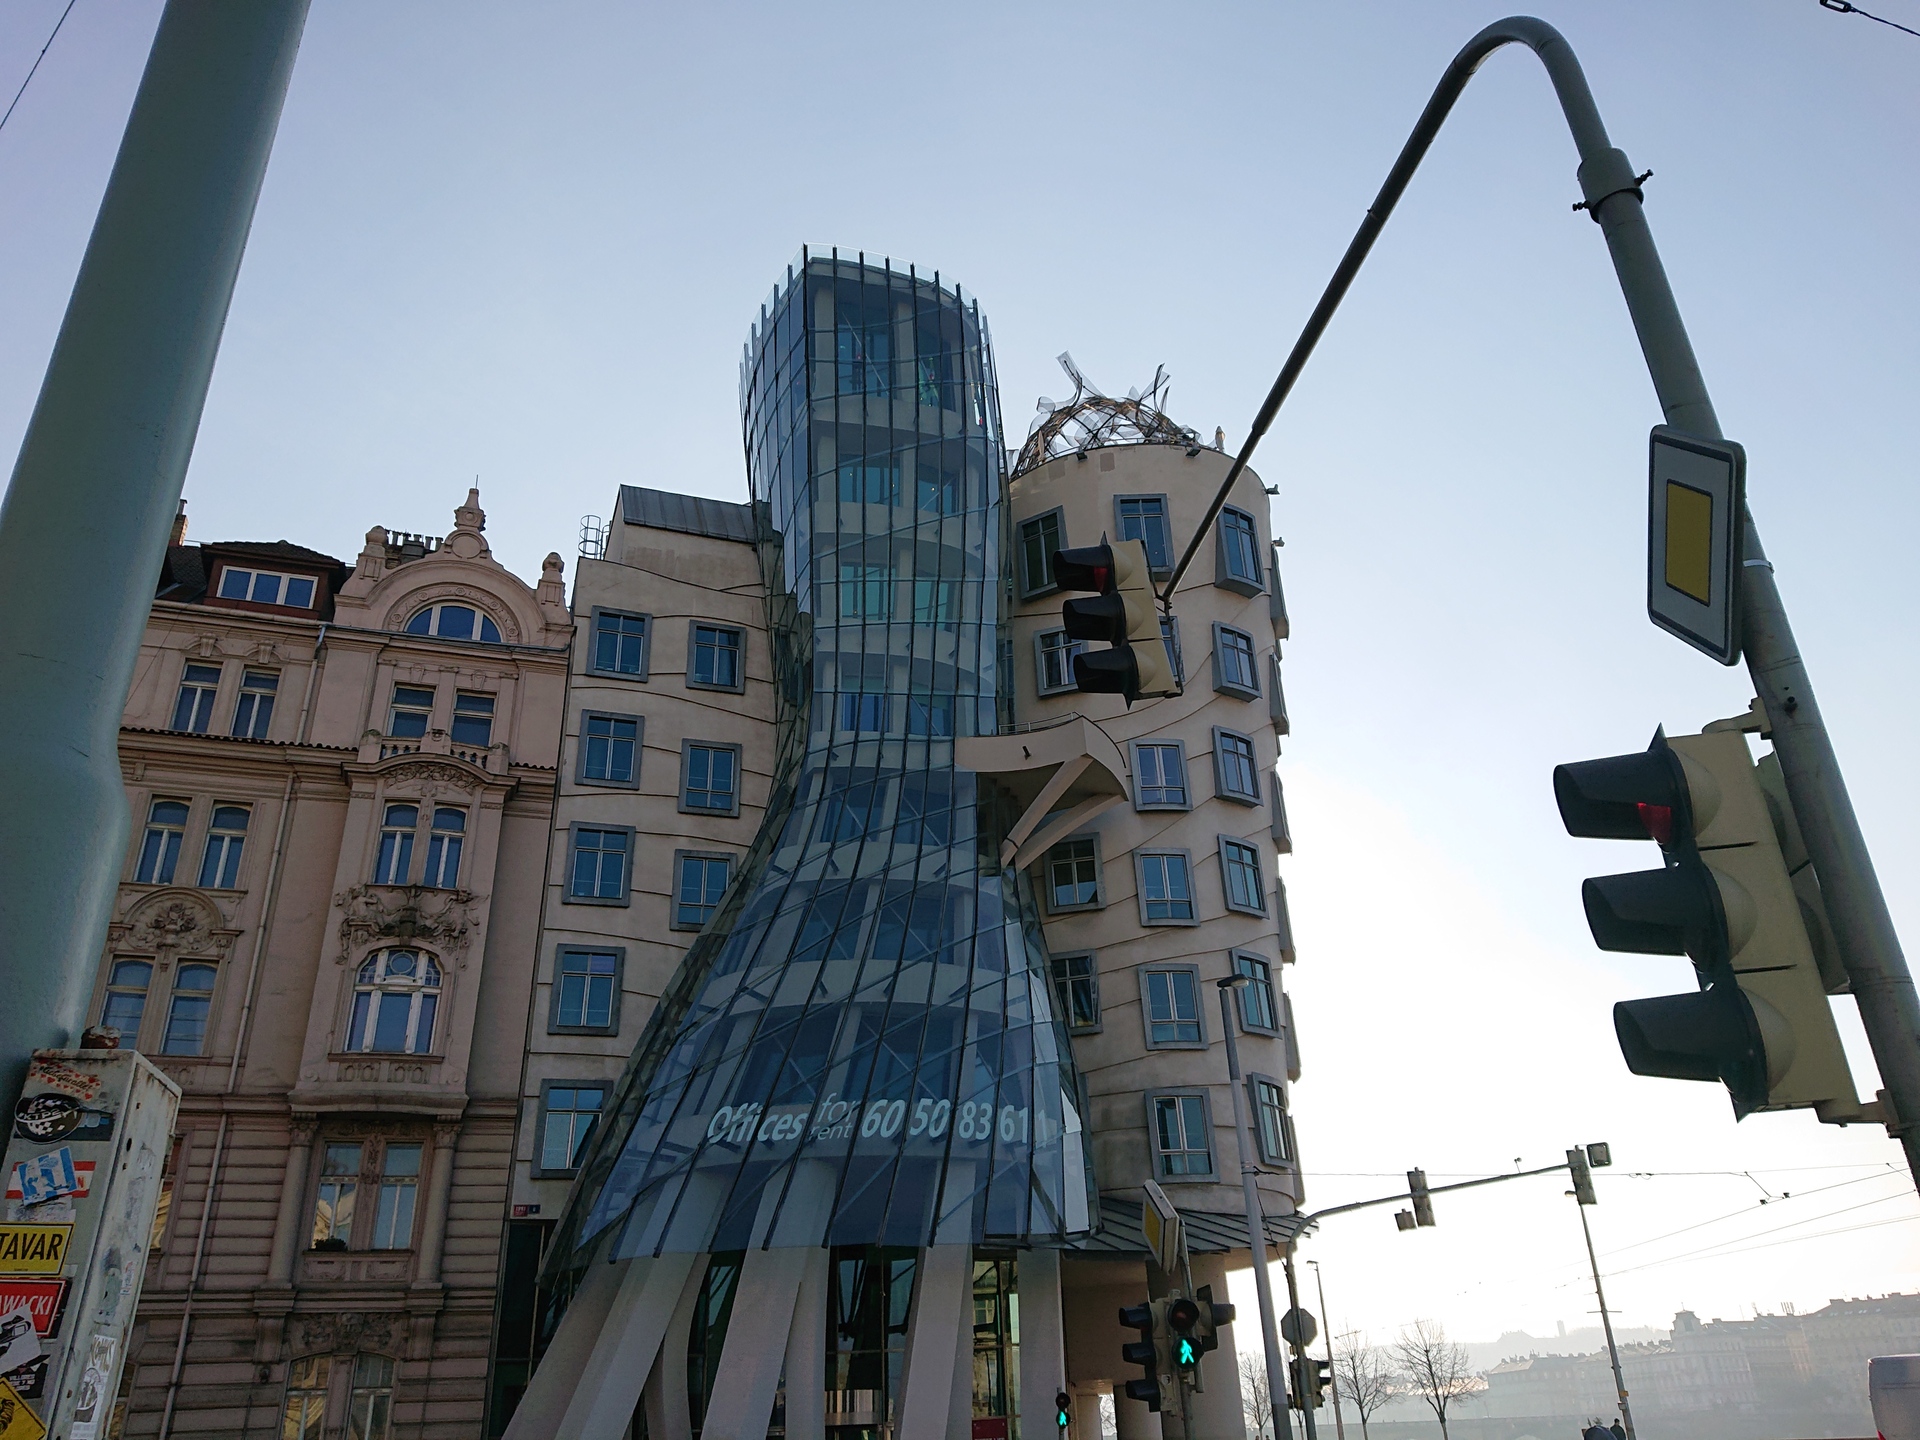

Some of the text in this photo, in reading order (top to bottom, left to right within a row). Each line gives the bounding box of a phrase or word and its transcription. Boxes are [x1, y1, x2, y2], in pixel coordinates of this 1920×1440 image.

[707, 1102, 809, 1143] Offices
[818, 1092, 864, 1122] for
[861, 1099, 906, 1138] 60
[910, 1098, 951, 1138] 50
[958, 1101, 993, 1140] 83
[809, 1123, 853, 1140] rent
